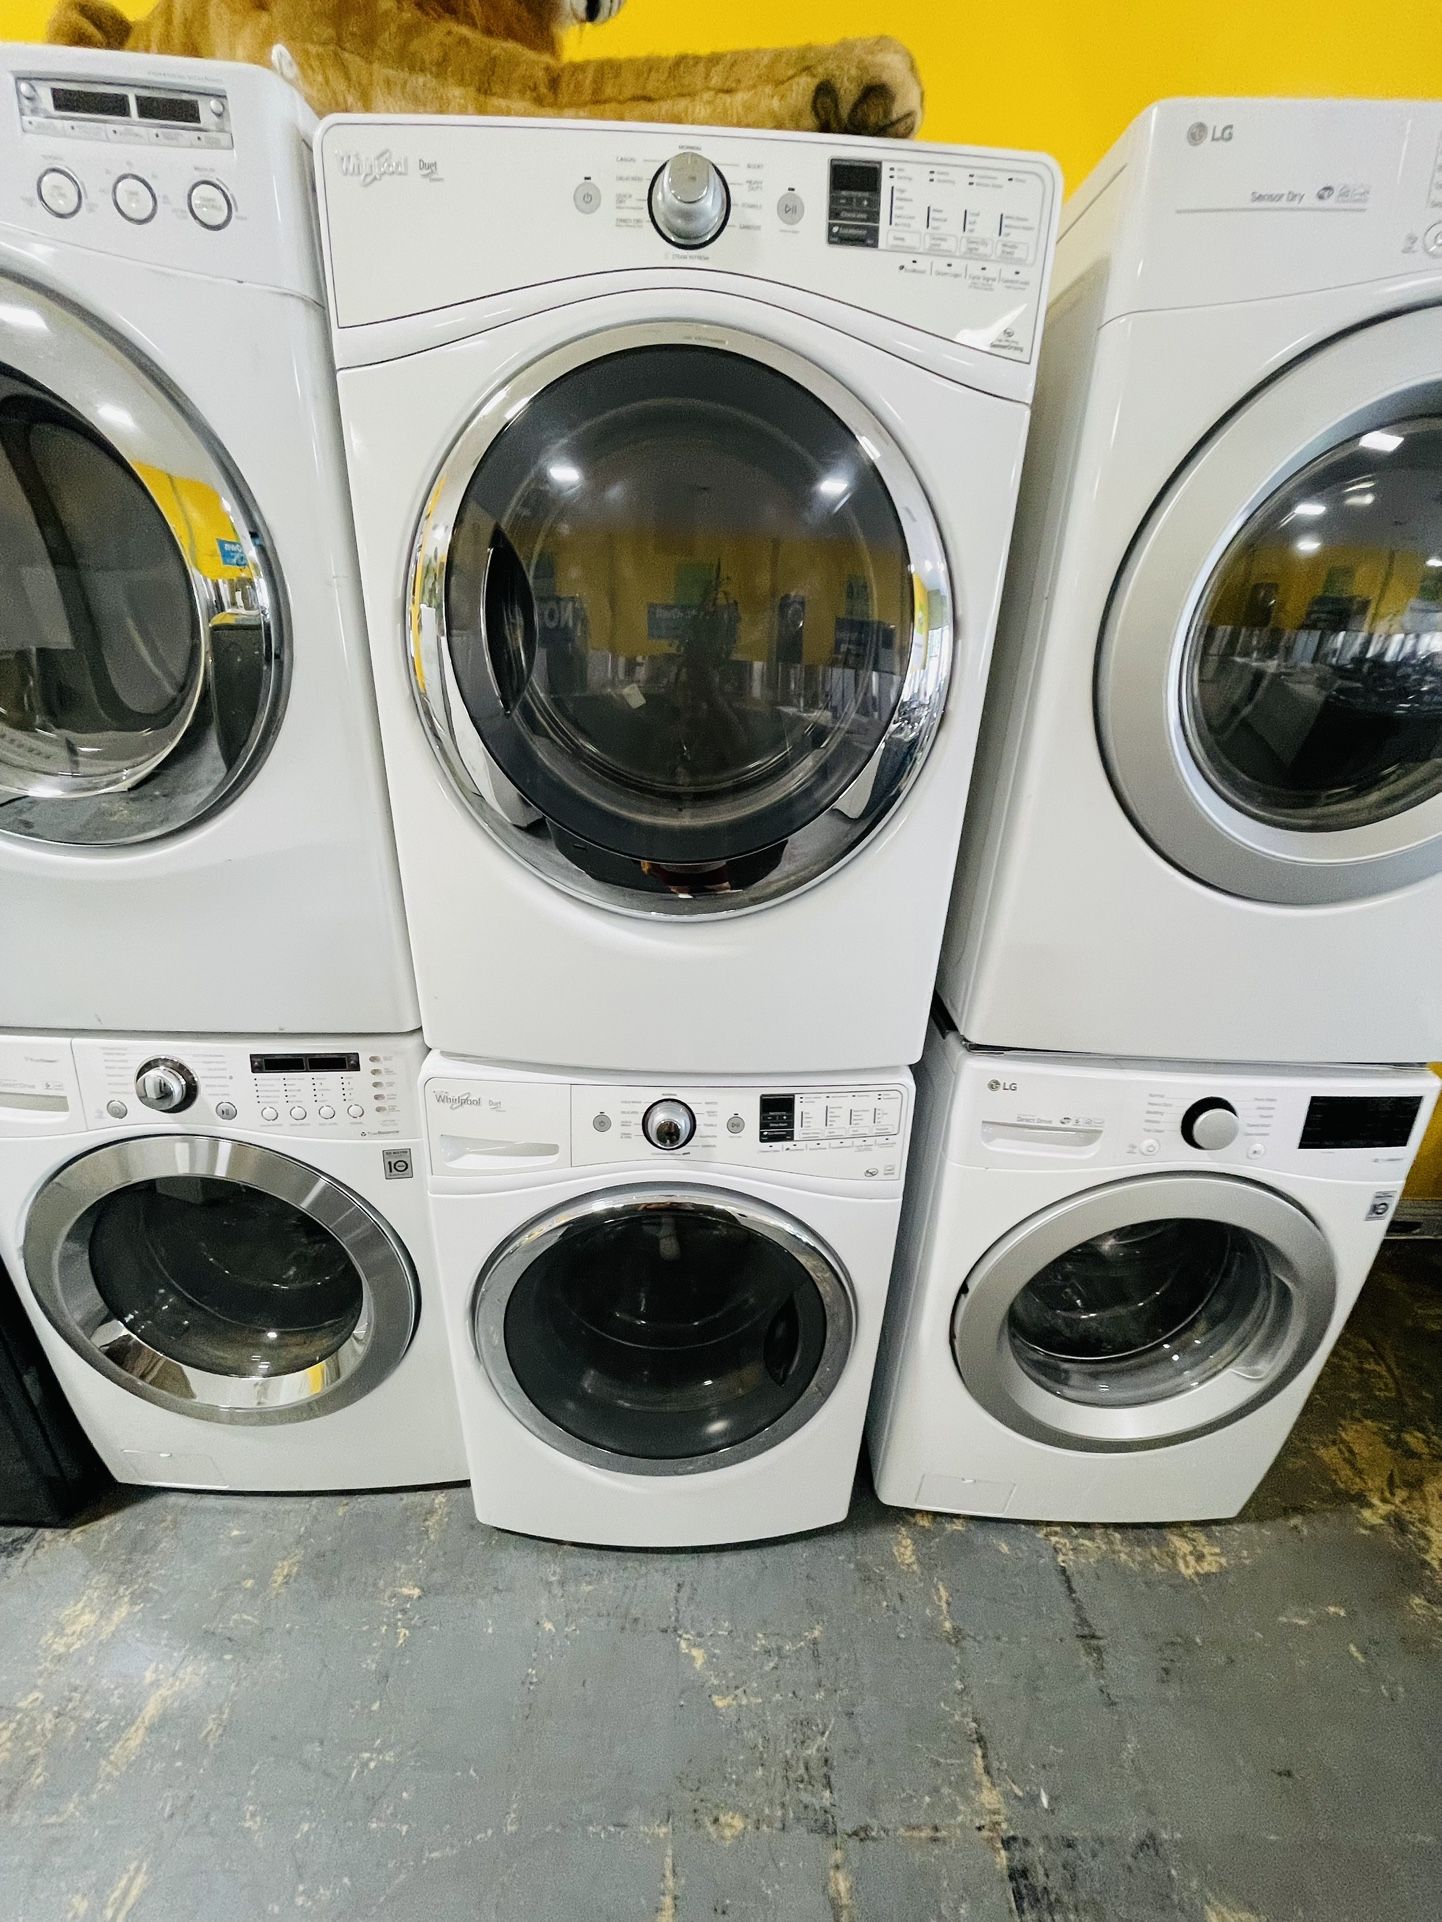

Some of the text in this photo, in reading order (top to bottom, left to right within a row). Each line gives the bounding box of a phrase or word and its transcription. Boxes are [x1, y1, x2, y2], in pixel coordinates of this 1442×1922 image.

[1211, 124, 1234, 142] LG
[1286, 190, 1306, 204] Dry
[1002, 1082, 1017, 1092] LG
[434, 1091, 481, 1110] Whirlpool
